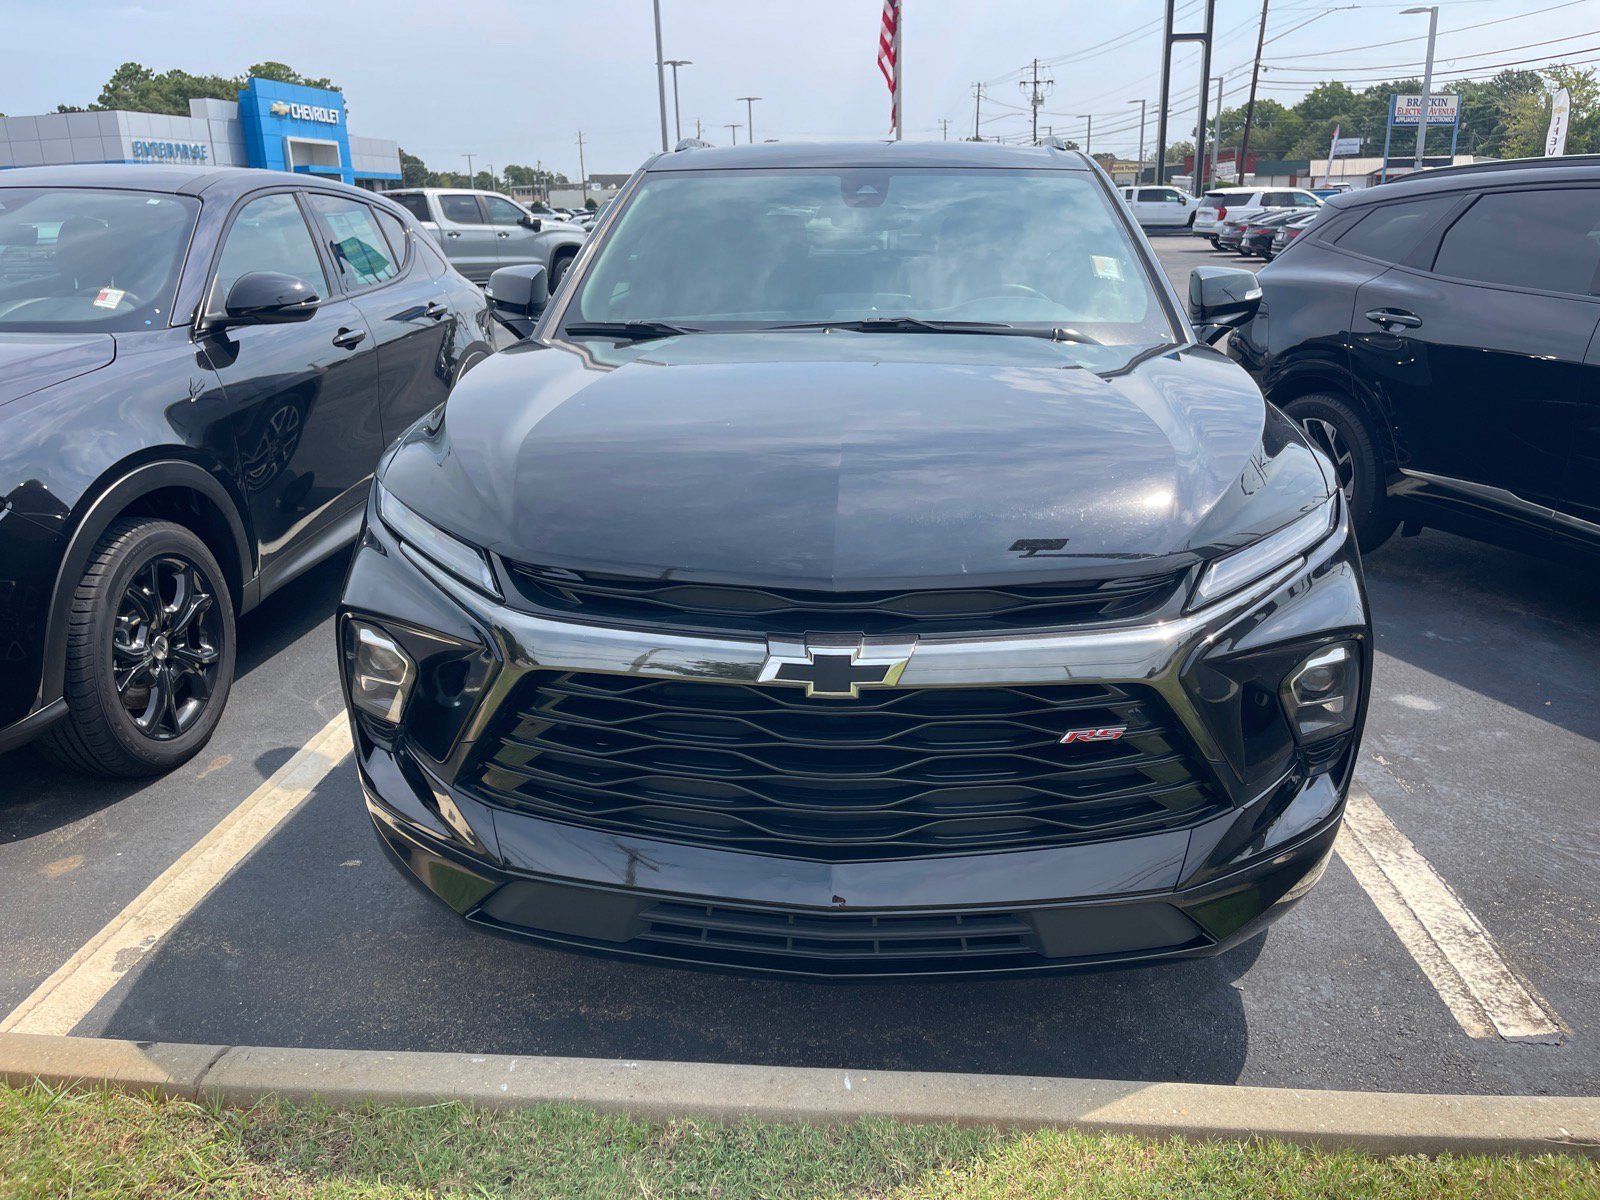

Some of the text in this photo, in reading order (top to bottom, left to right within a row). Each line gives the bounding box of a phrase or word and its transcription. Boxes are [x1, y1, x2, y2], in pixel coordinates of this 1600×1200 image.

[1407, 98, 1448, 107] BRKIN
[291, 103, 339, 124] CHEVROLET
[1397, 107, 1456, 116] ELECTR AVENUE
[1059, 726, 1127, 744] RS
